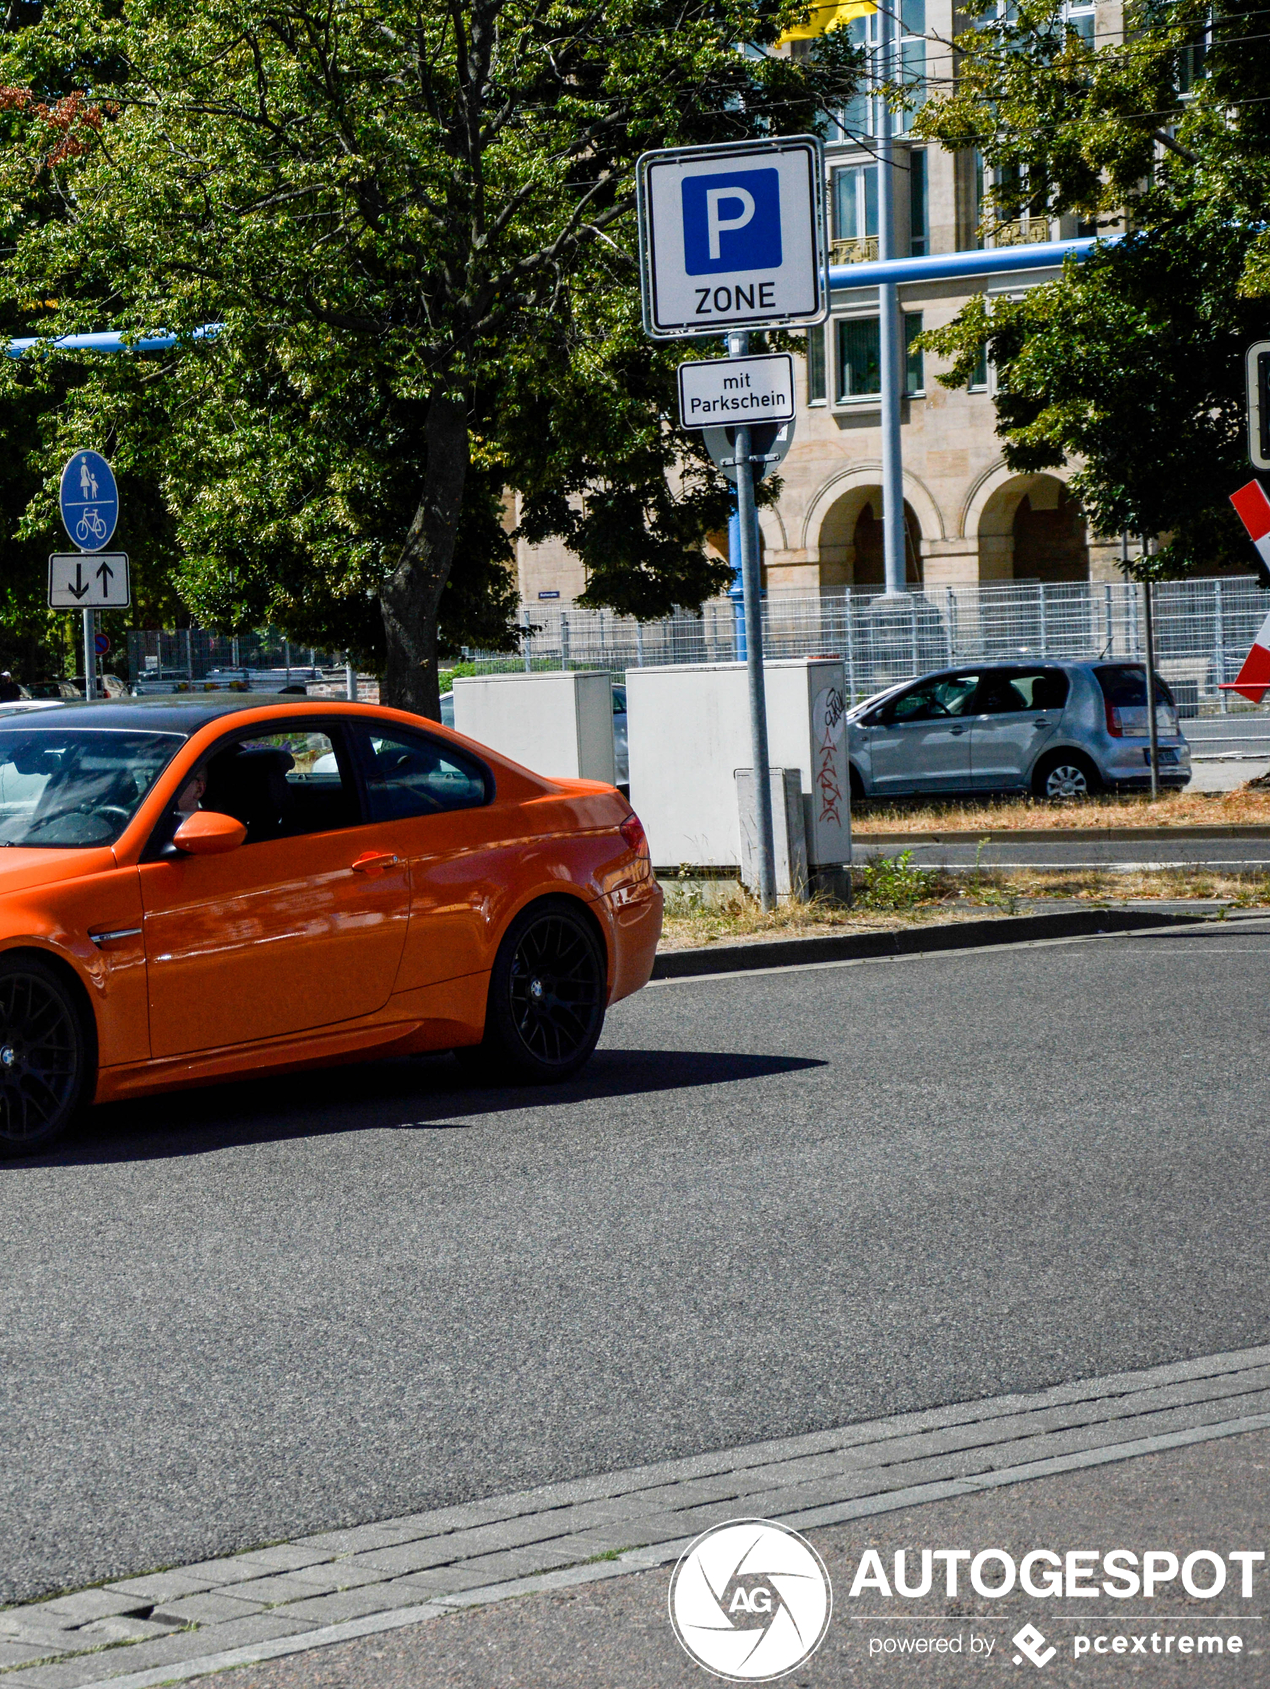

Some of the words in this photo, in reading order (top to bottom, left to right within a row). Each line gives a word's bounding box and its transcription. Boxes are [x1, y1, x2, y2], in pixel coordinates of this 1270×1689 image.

[706, 186, 756, 260] P
[695, 282, 776, 314] ZONE
[723, 372, 751, 389] mit
[690, 390, 785, 413] Parkschein
